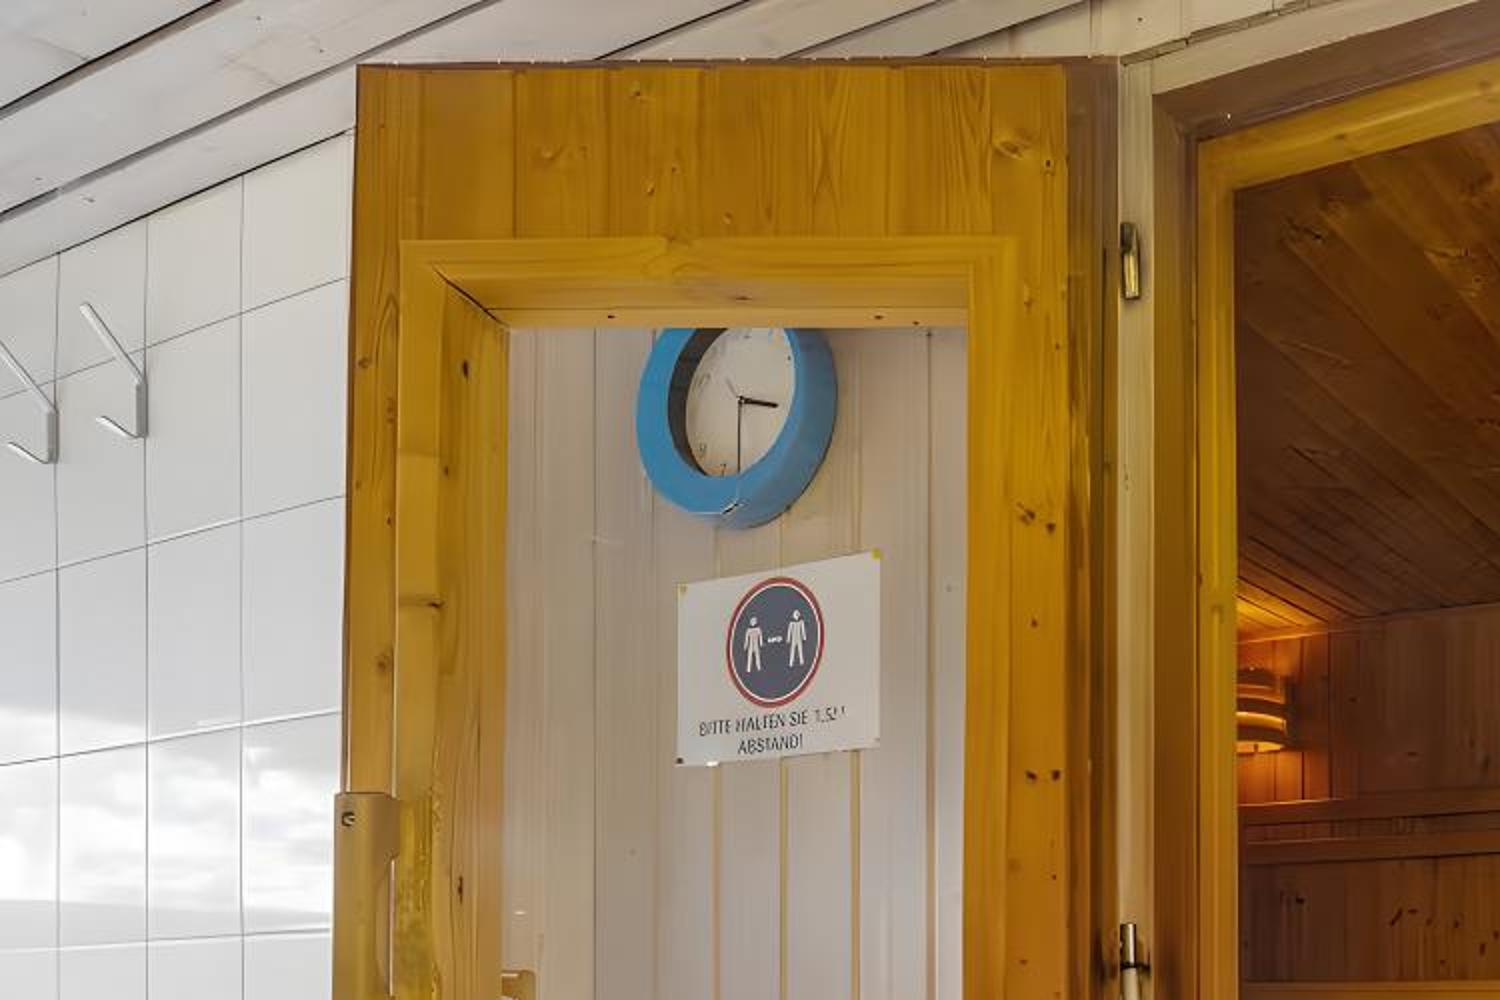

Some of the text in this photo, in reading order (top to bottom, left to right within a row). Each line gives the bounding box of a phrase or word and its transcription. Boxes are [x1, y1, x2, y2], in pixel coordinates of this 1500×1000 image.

[699, 719, 731, 737] BITTE
[735, 713, 785, 733] HALTEN
[789, 709, 808, 727] SIE
[738, 733, 803, 755] ABSTAND!
